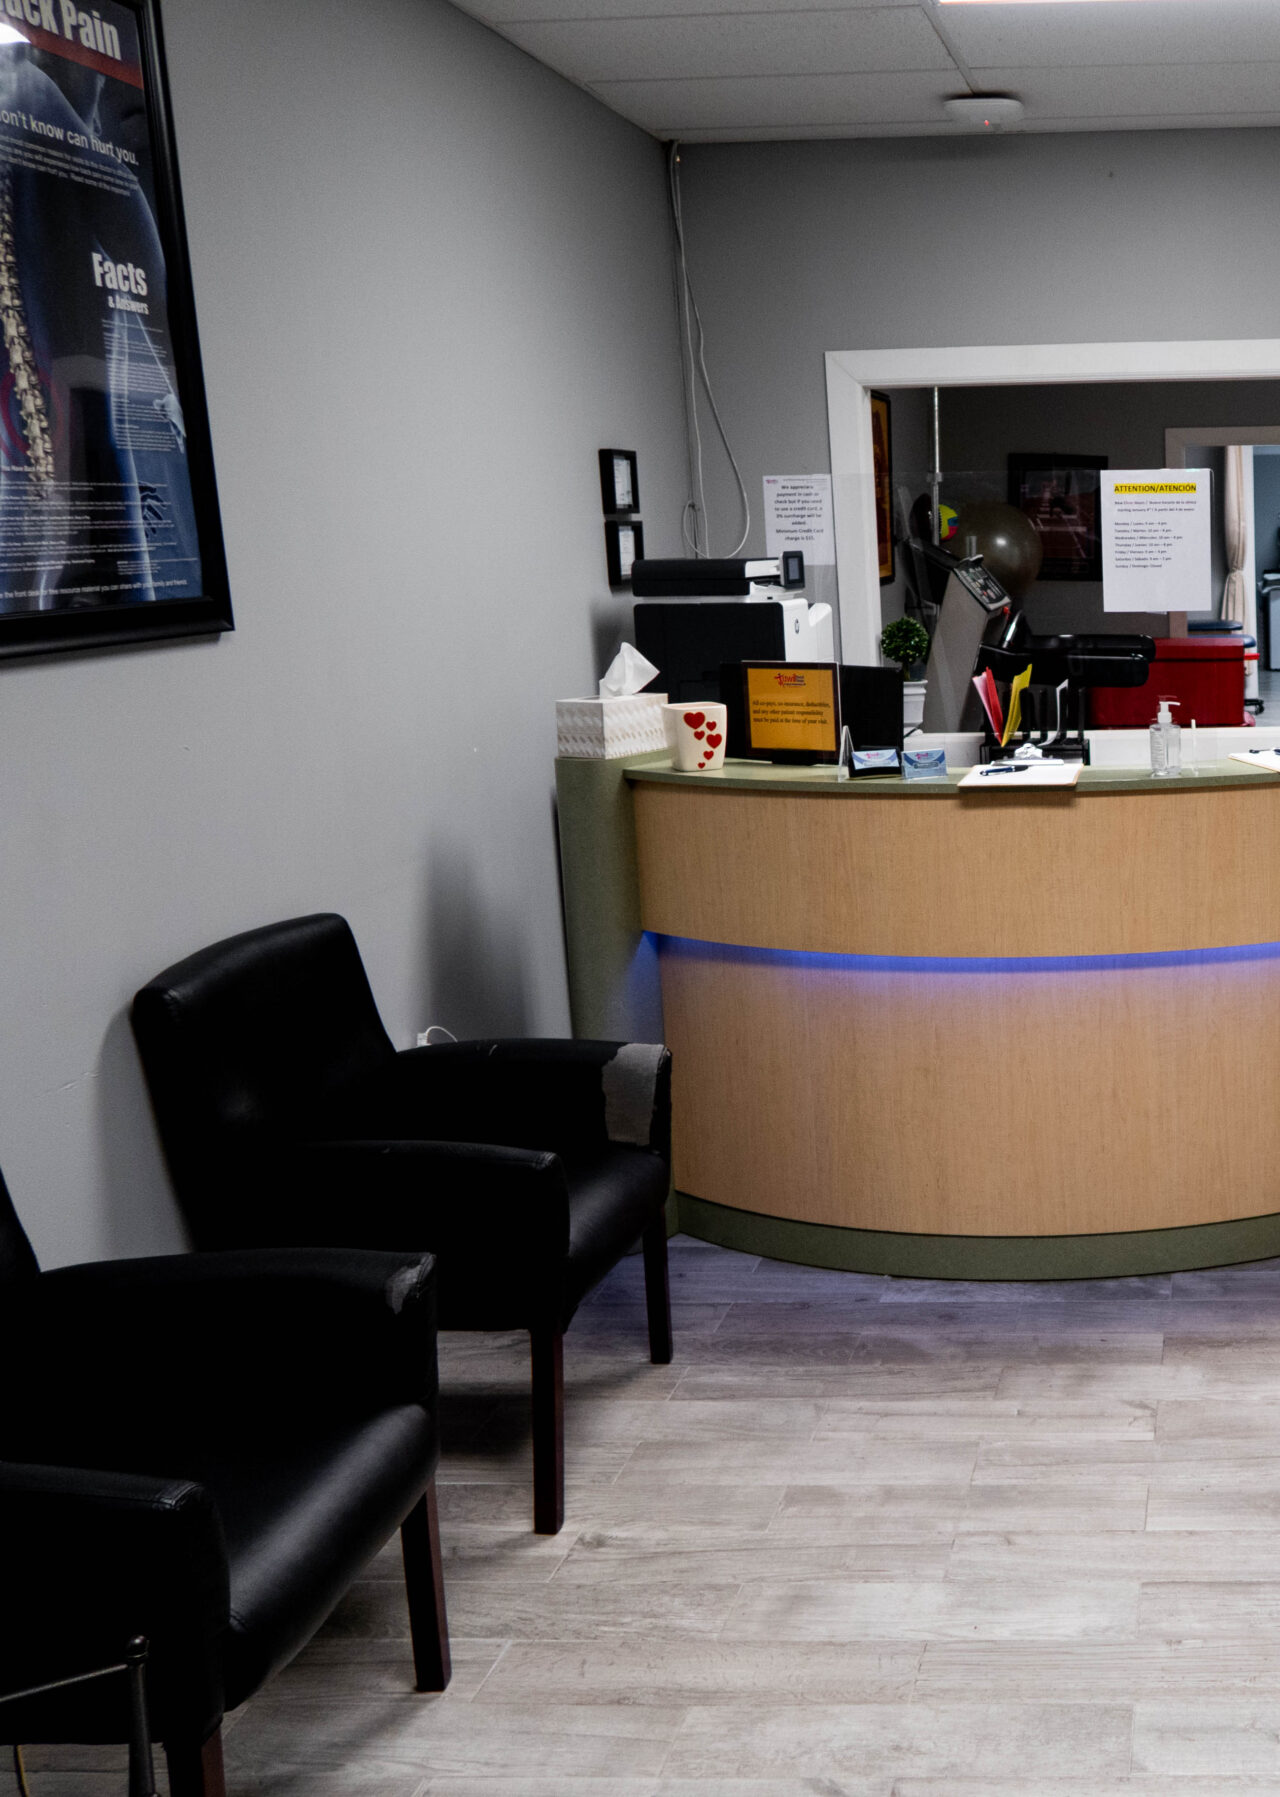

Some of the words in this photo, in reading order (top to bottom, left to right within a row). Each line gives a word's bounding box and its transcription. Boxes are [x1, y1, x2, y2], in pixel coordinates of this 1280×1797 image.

[0, 0, 58, 34] ack
[61, 0, 121, 61] Pain
[0, 109, 28, 130] on't
[30, 114, 64, 140] know
[67, 130, 88, 148] can
[90, 134, 114, 157] hurt
[115, 146, 139, 166] you.
[91, 252, 148, 296] Facts
[108, 295, 115, 308] &
[115, 295, 150, 315] Answers
[1114, 484, 1196, 492] ATTENTION/ATENCIÓN
